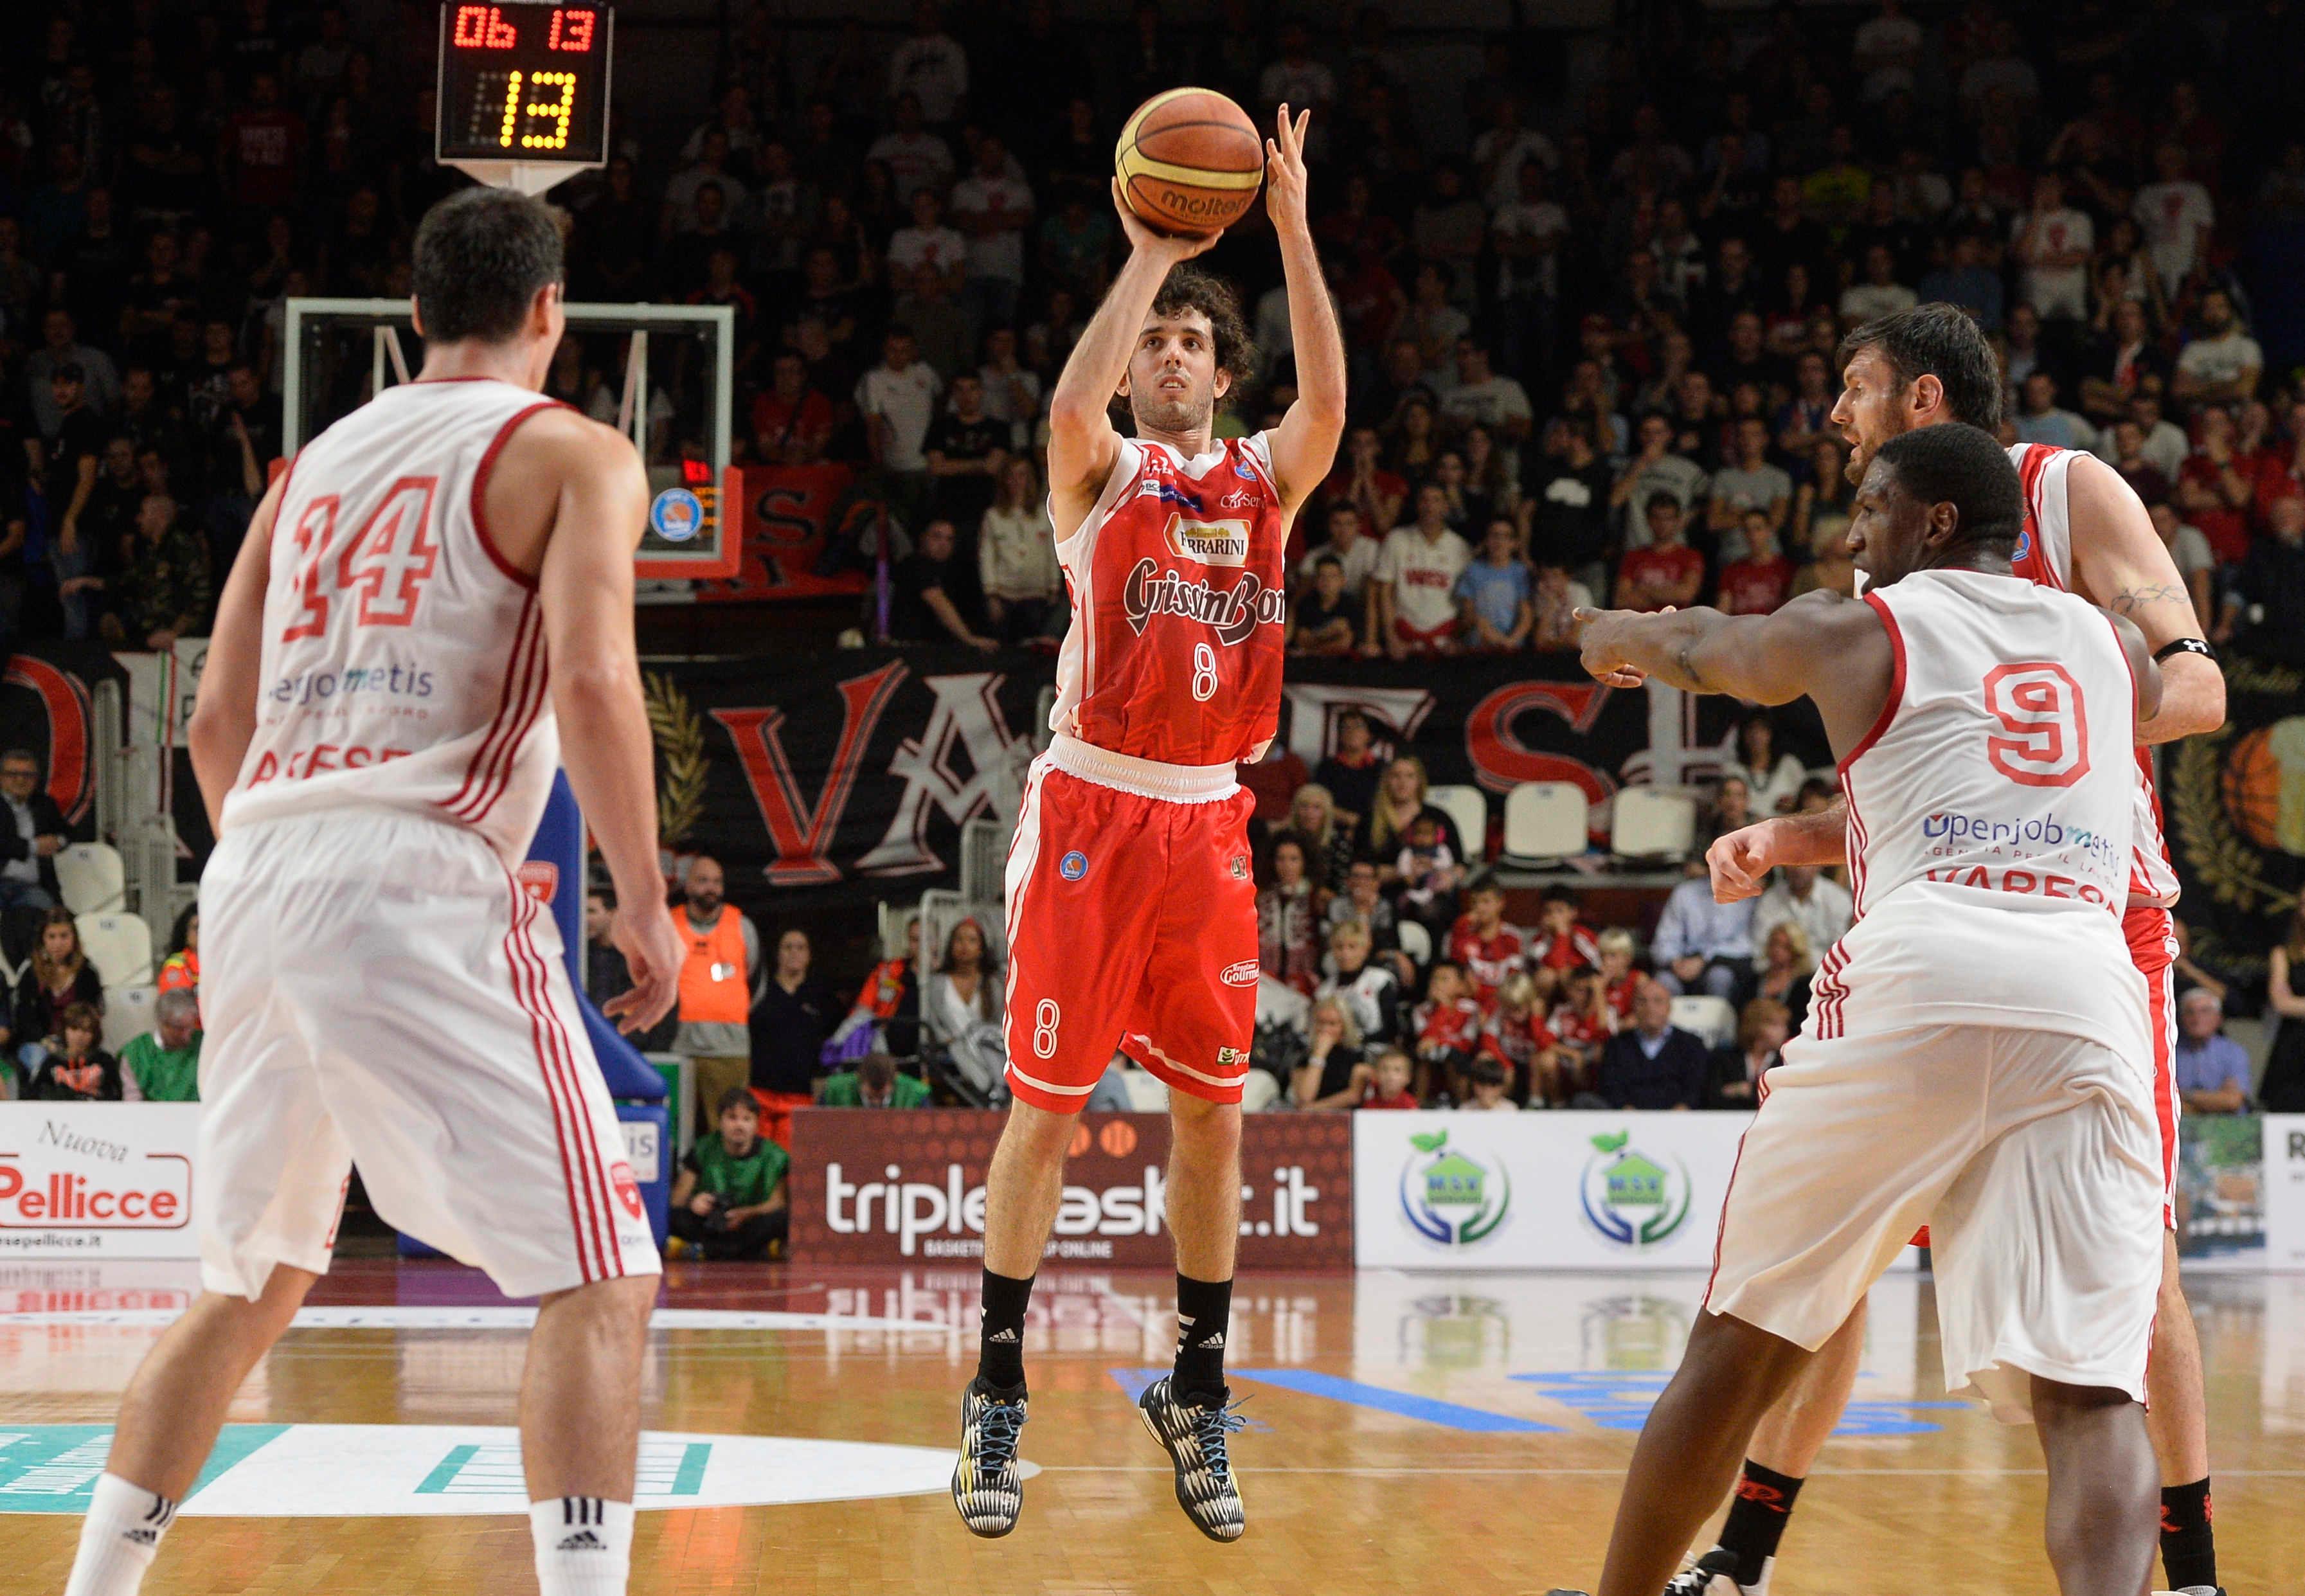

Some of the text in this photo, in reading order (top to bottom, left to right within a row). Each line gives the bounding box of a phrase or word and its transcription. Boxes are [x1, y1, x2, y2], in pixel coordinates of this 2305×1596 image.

[549, 10, 595, 51] 13
[499, 70, 576, 149] 13
[282, 476, 438, 643] 14
[1180, 531, 1245, 555] FRRARINI
[1192, 642, 1218, 702] 8
[1983, 662, 2091, 787] 9
[1033, 998, 1061, 1060] 8
[37, 1119, 129, 1164] Nuova
[0, 1165, 178, 1219] Pellicce
[826, 1161, 1320, 1257] tripleask.it
[0, 1233, 101, 1249] sepellicce.it
